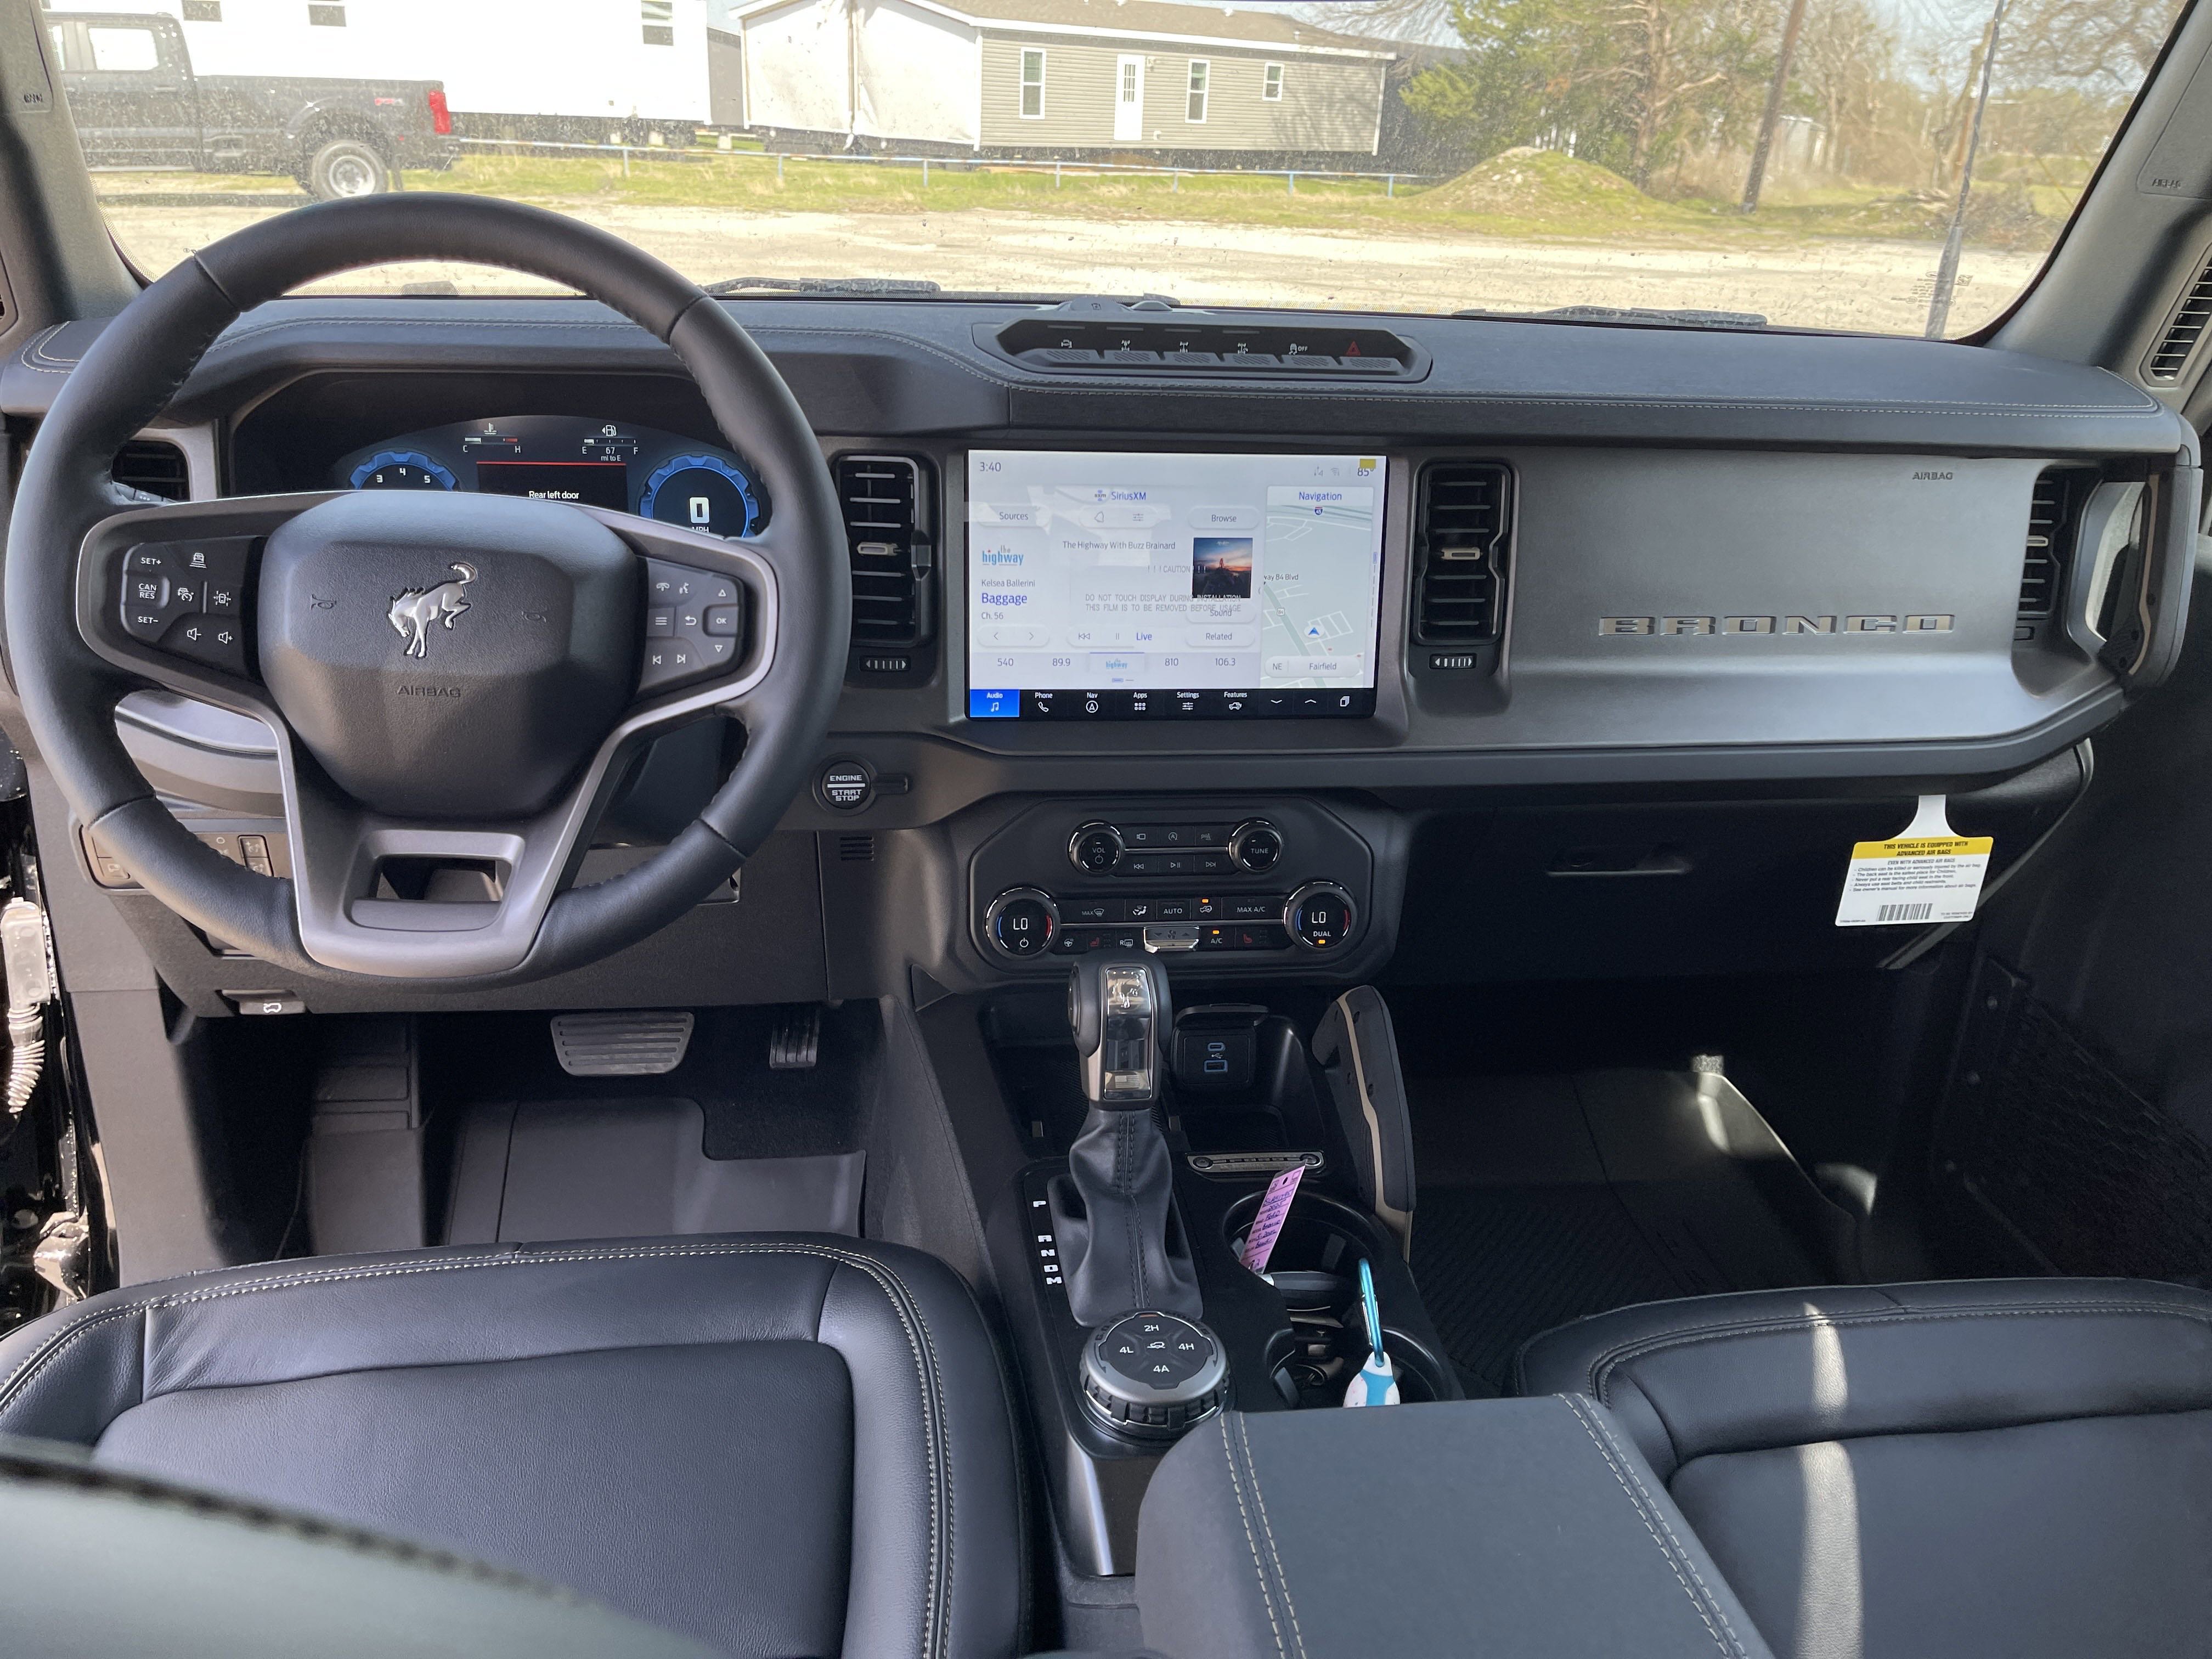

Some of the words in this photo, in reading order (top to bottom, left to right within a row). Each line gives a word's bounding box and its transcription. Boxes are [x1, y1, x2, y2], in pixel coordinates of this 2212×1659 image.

[979, 462, 1001, 472] 3:40
[376, 475, 383, 483] 3
[1912, 471, 1954, 481] AIRBAG
[548, 491, 561, 499] left
[562, 491, 579, 499] door
[1111, 492, 1146, 500] SiriusXM
[1299, 491, 1342, 502] Navigation
[690, 497, 709, 523] 0
[999, 511, 1029, 520] Sources
[1001, 545, 1011, 554] the
[1063, 541, 1076, 549] The
[1077, 541, 1108, 550] Highway
[140, 557, 161, 565] SET+
[982, 550, 1024, 566] highway
[981, 593, 1028, 606] Baggage
[1598, 614, 1956, 636] BRONCO
[1136, 633, 1152, 641] Live
[997, 658, 1014, 667] 540
[1052, 658, 1071, 667] 89.9
[1165, 658, 1179, 667] 810
[1215, 658, 1236, 667] 106.3
[1309, 662, 1337, 670] Fairfield
[397, 684, 461, 698] AIRBAG
[1177, 691, 1200, 699] Settings
[1311, 911, 1327, 923] LO
[1013, 918, 1028, 930] LO
[1041, 1249, 1056, 1257] N
[1046, 1277, 1062, 1285] M
